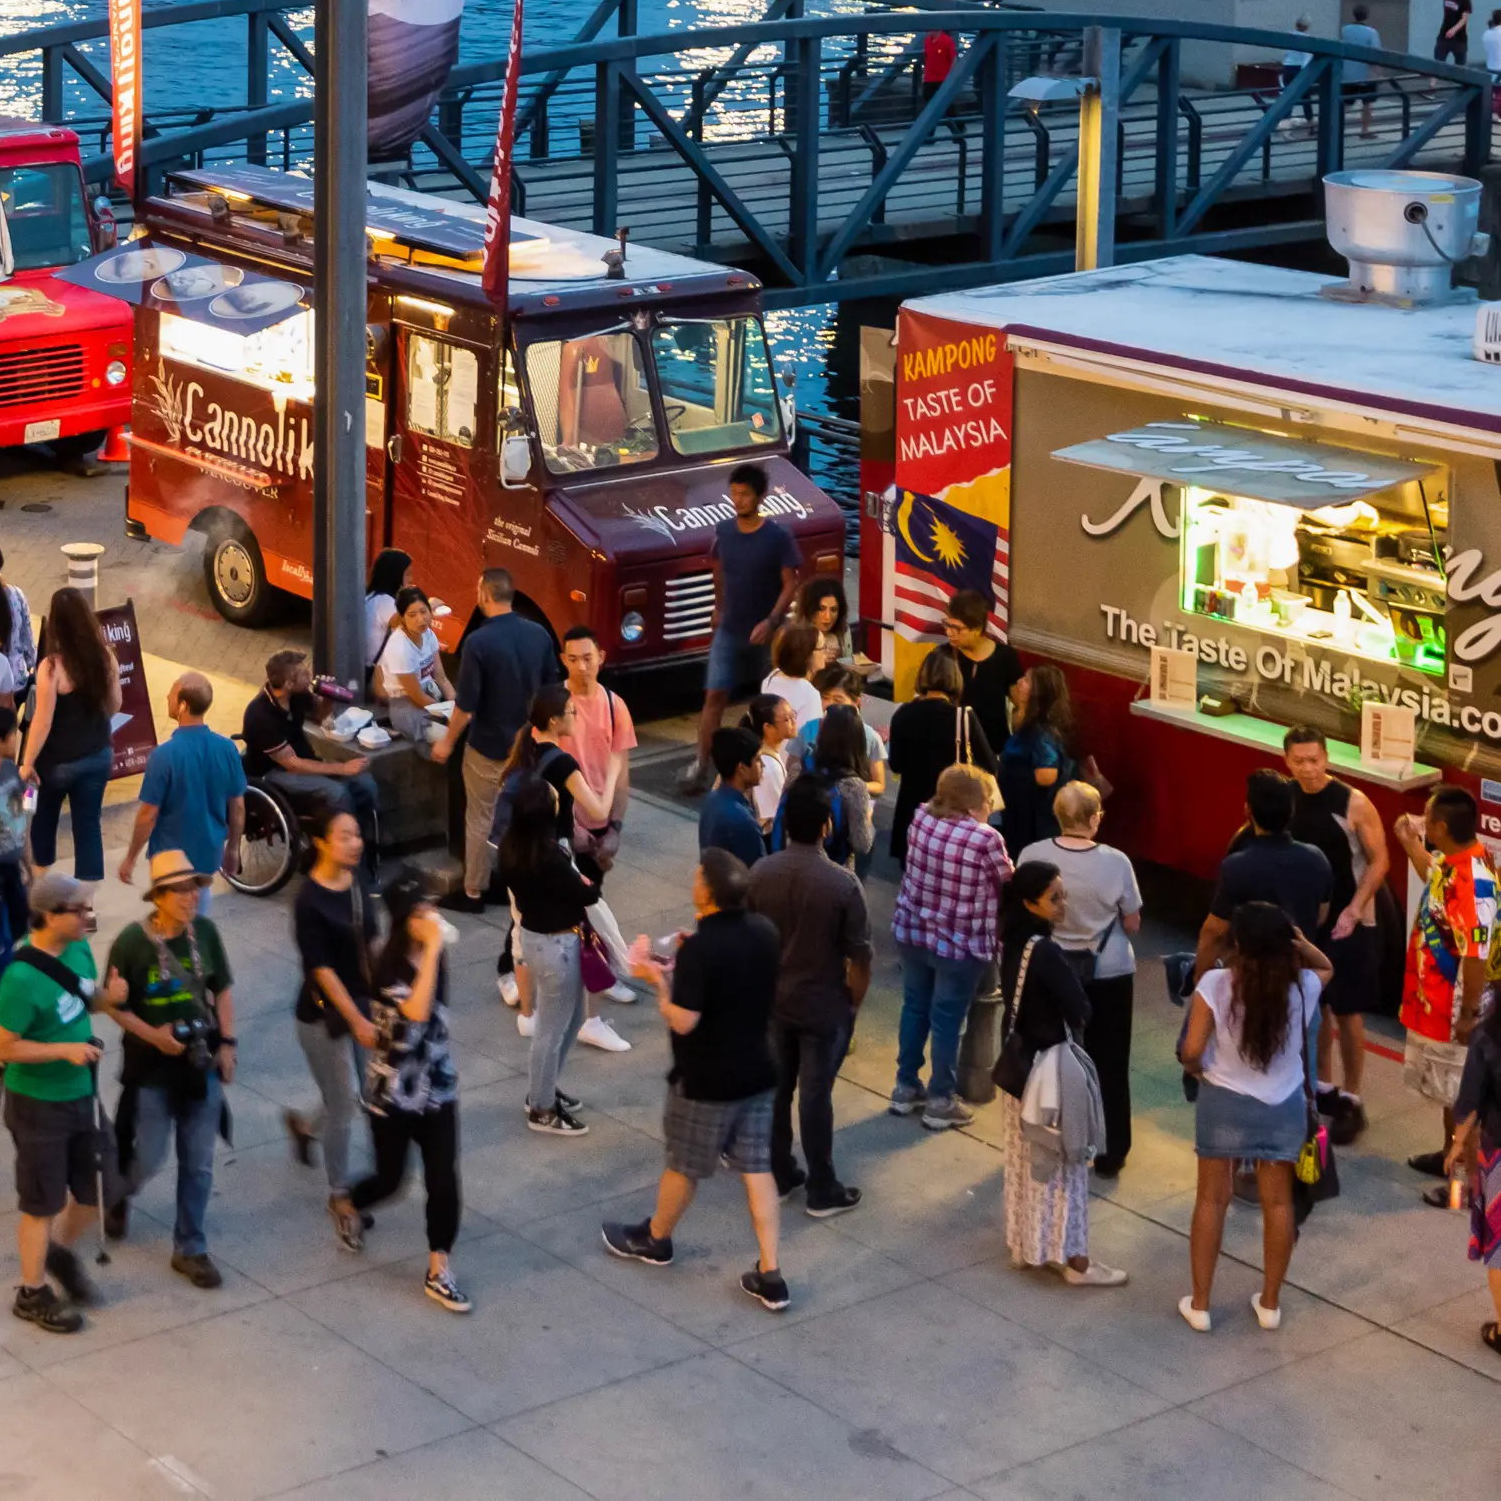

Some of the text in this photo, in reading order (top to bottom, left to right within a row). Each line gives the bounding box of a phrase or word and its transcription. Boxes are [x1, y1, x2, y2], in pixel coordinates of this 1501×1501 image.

[903, 334, 996, 383] KAMPONG
[903, 379, 996, 421] TASTE OF
[184, 382, 314, 480] Cannolik
[900, 417, 1008, 462] MALAYSIA
[505, 520, 532, 538] original
[1100, 603, 1157, 648] The
[1163, 620, 1247, 672] Taste
[1256, 645, 1295, 683] Of
